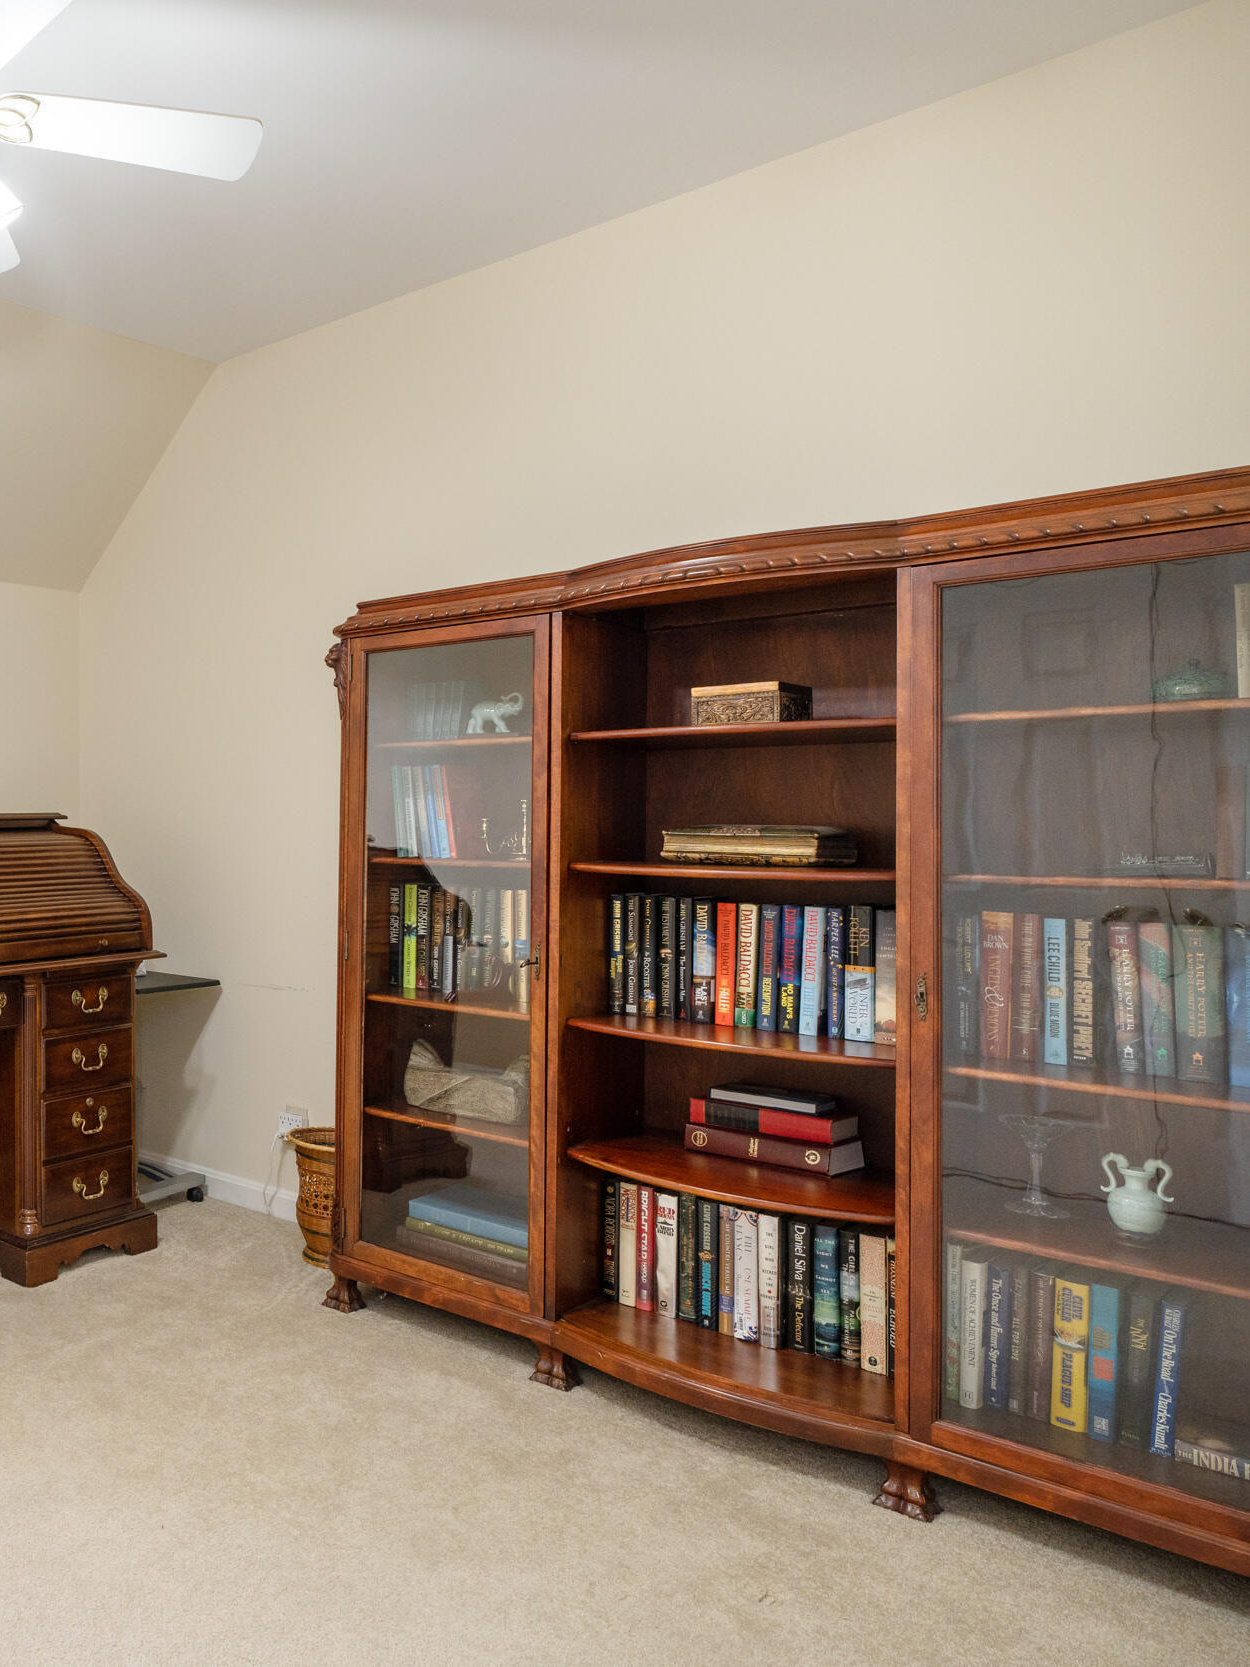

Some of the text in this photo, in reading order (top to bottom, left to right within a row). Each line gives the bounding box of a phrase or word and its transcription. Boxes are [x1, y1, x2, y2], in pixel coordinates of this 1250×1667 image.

[390, 888, 399, 944] JOHN GRISHAM
[417, 888, 428, 935] JOHN GRISHAM
[613, 900, 622, 952] JOHN GRISHAM
[721, 919, 730, 940] DAVID
[696, 905, 708, 976] DAVID BALDACCI
[738, 909, 753, 988] DAVID BALDACCI
[764, 920, 774, 941] DAVID
[782, 908, 797, 981] DAVID BALDACCI
[804, 909, 819, 982] DAVID BALDACCI
[830, 911, 839, 958] HARPER LEE
[849, 917, 859, 956] FOLLETT
[859, 927, 870, 947] KEN
[983, 941, 1008, 949] BROWN
[988, 934, 1005, 942] DAN
[1074, 919, 1092, 978] John Sandford
[616, 955, 624, 973] Rogue
[643, 957, 651, 987] ROOSTER
[720, 942, 730, 976] BALDACCI
[763, 942, 774, 975] BALDACCI
[832, 967, 838, 975] GO
[987, 953, 1001, 989] ANGELS
[1020, 922, 1033, 988] THE DA VINCI CODE
[1047, 936, 1061, 982] LEE CHILD
[1157, 950, 1167, 986] HARRY
[628, 959, 636, 1004] JOHN GRISHAM
[661, 963, 669, 1007] JOHN GRISHAM
[700, 986, 708, 1006] LAST
[761, 977, 772, 1016] REDEMPTION
[1122, 948, 1135, 1032] HARRY POTTER
[1196, 952, 1207, 1038] HARRY POTTER
[717, 987, 730, 1014] FALLEN
[786, 983, 794, 1019] NO MAN'S
[803, 985, 815, 1018] THE HIT
[848, 986, 858, 1024] WORLD
[858, 981, 870, 1019] WINTER
[1020, 993, 1032, 1007] DAN
[1073, 980, 1093, 1025] SECRET
[1049, 1002, 1060, 1039] BLUE MOON
[1073, 1026, 1093, 1058] PREY
[605, 1196, 616, 1245] NORA ROBERTS
[620, 1187, 630, 1220] MOSCOW
[629, 1189, 637, 1223] BREAKING
[655, 1206, 675, 1216] RED
[640, 1190, 649, 1260] BRIGHT STAR
[703, 1204, 711, 1250] CLIVE CUSSLER
[725, 1224, 731, 1233] MY
[794, 1225, 806, 1281] Daniel Silva
[848, 1239, 856, 1254] THE
[701, 1261, 711, 1317] SHOCK WAVE
[724, 1285, 730, 1294] ME
[815, 1274, 836, 1283] CANNOT
[795, 1297, 804, 1343] The Defector
[967, 1278, 977, 1368] WOMEN OF ACHIEVEMENT
[988, 1278, 1003, 1364] The Once and Future Spy
[1011, 1317, 1019, 1329] ALL
[1061, 1287, 1073, 1323] CUSSLER
[1072, 1295, 1083, 1320] CLIVE
[1171, 1309, 1181, 1332] CHARLES
[1011, 1331, 1020, 1344] FOR
[1011, 1345, 1020, 1361] LOVE
[1160, 1330, 1177, 1382] On The Road
[1061, 1352, 1073, 1408] PLAGUE SHIP
[1154, 1392, 1172, 1450] Charles Kuralt
[1178, 1448, 1240, 1478] THE INDIA
